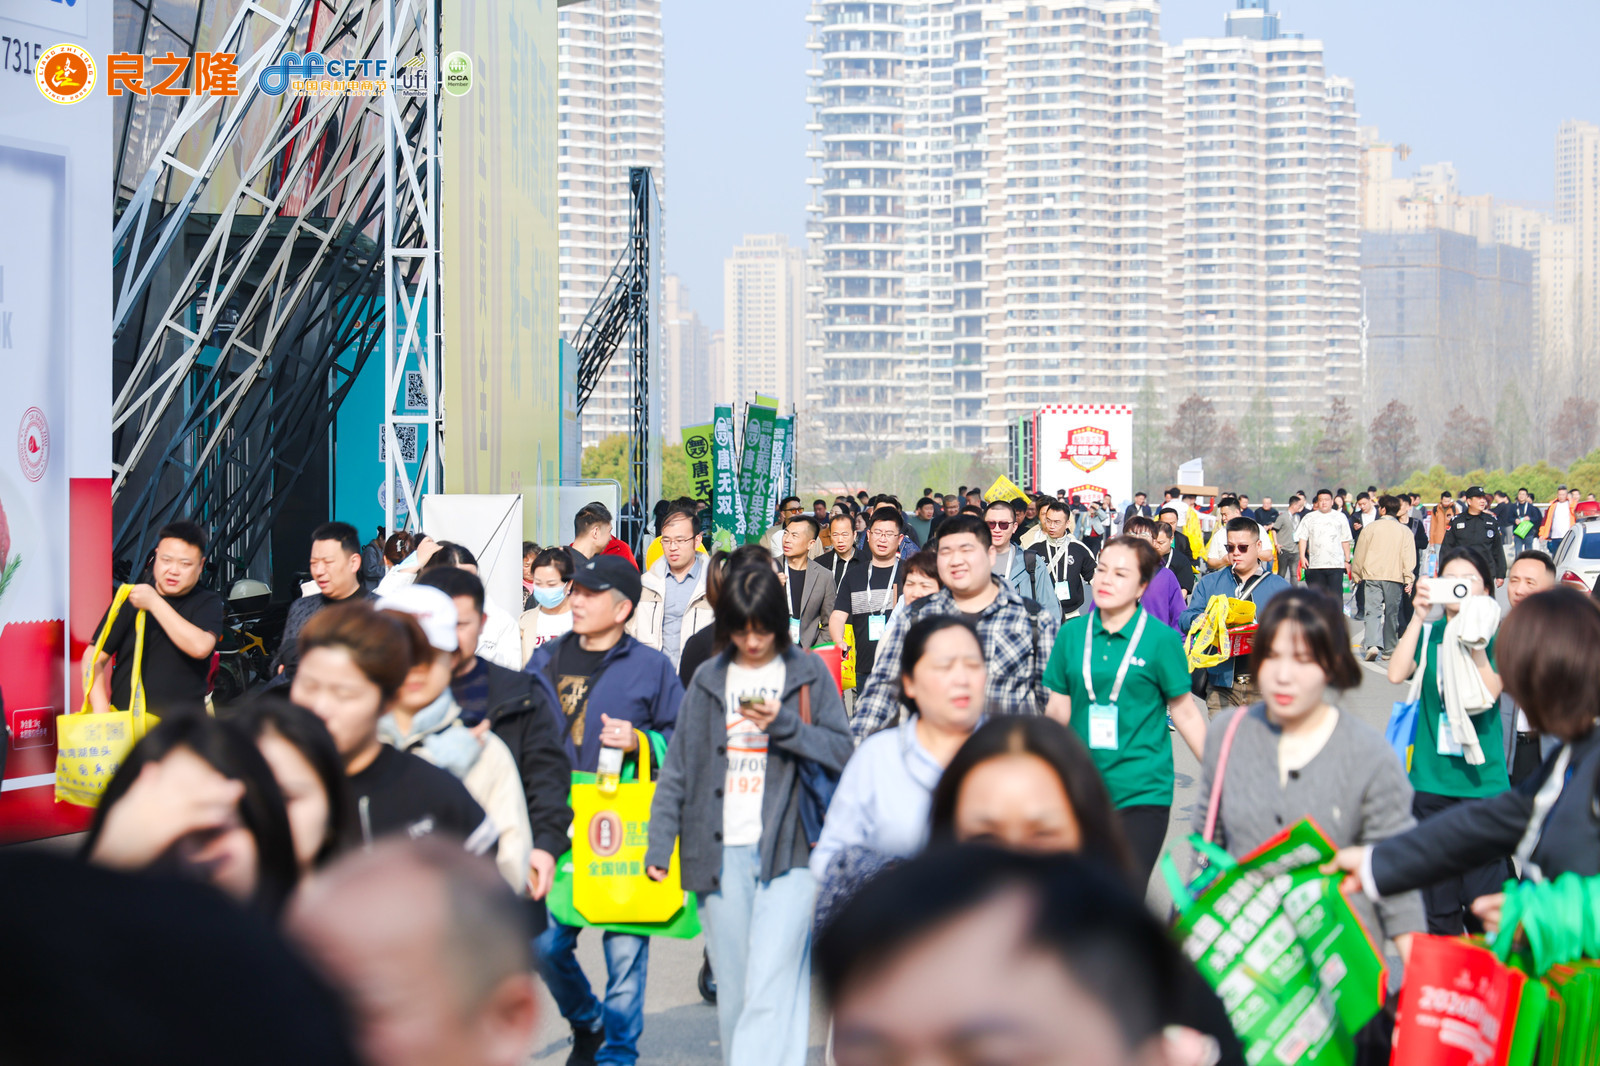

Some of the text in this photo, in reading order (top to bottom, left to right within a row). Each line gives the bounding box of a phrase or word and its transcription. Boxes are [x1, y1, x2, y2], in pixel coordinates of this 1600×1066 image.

[716, 449, 733, 515] 唐无双
[747, 434, 772, 536] 整颗水果茶
[588, 861, 645, 877] 全国销量
